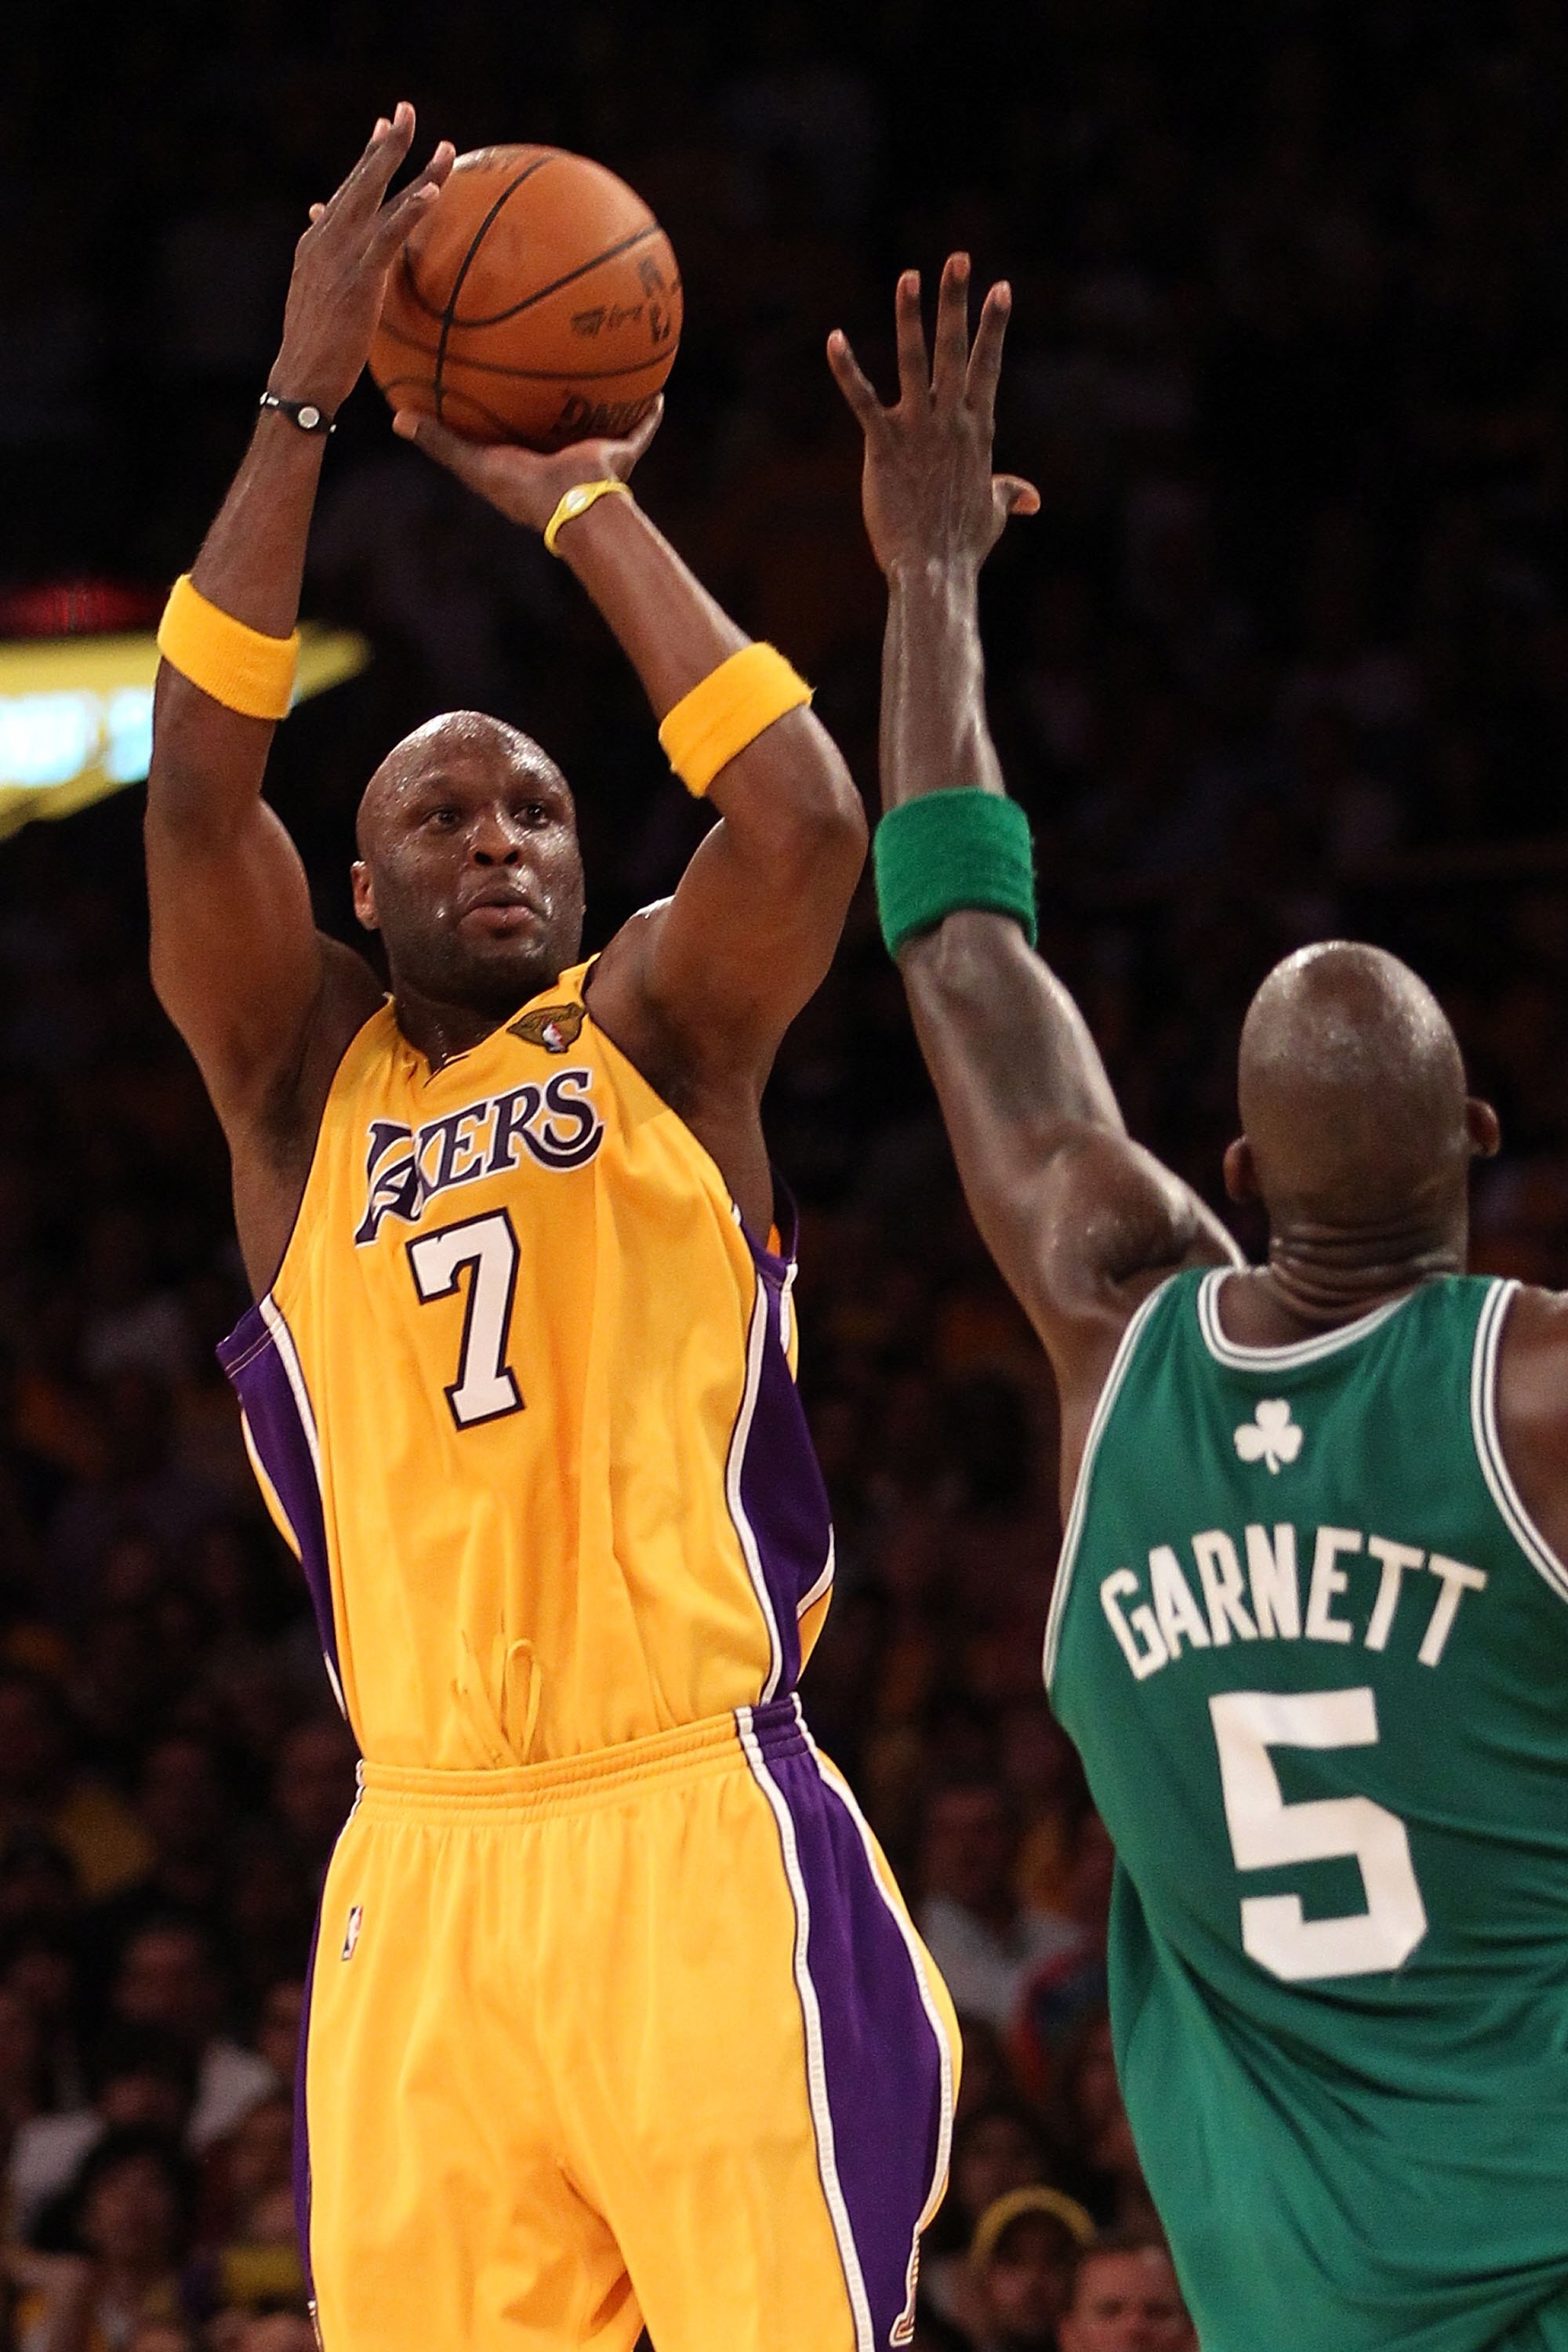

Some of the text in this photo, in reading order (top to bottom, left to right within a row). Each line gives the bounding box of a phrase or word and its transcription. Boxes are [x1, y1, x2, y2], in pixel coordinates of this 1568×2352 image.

[405, 1207, 525, 1431] 7
[1100, 1523, 1486, 1680] GARNETT
[1208, 1686, 1428, 1982] 5
